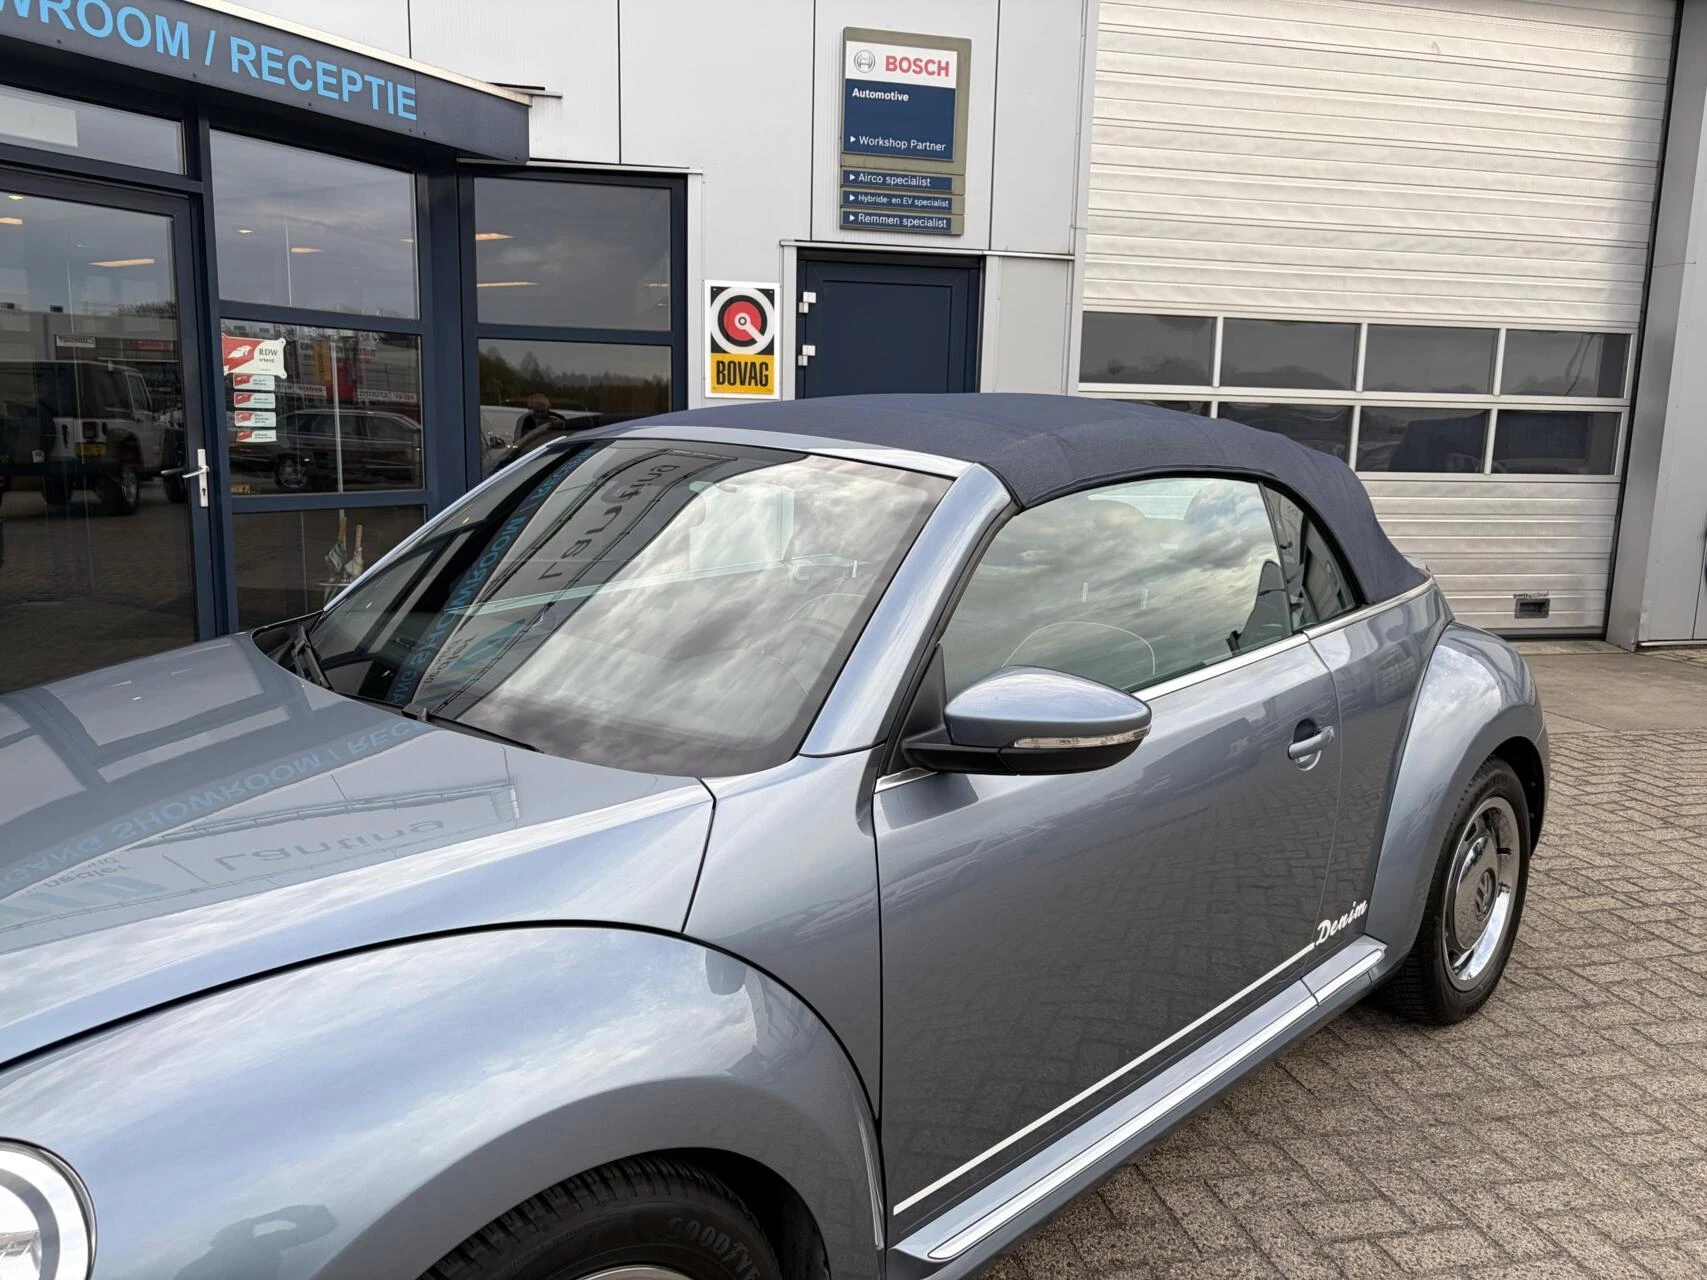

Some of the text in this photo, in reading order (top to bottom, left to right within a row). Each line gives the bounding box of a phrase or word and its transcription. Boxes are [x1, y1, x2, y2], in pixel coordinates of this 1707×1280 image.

[885, 55, 950, 77] BOSCH
[230, 36, 418, 121] RECEPTIE
[852, 88, 909, 102] Automotive
[859, 135, 946, 151] Workshop Partner
[858, 172, 931, 187] Airco specialist
[858, 193, 890, 204] Hybride-
[903, 197, 913, 205] EV
[914, 198, 949, 208] specialist
[858, 213, 947, 228] Remmen specialist
[259, 348, 278, 356] RDW
[716, 360, 769, 387] BOVAG
[1315, 899, 1367, 946] Denim
